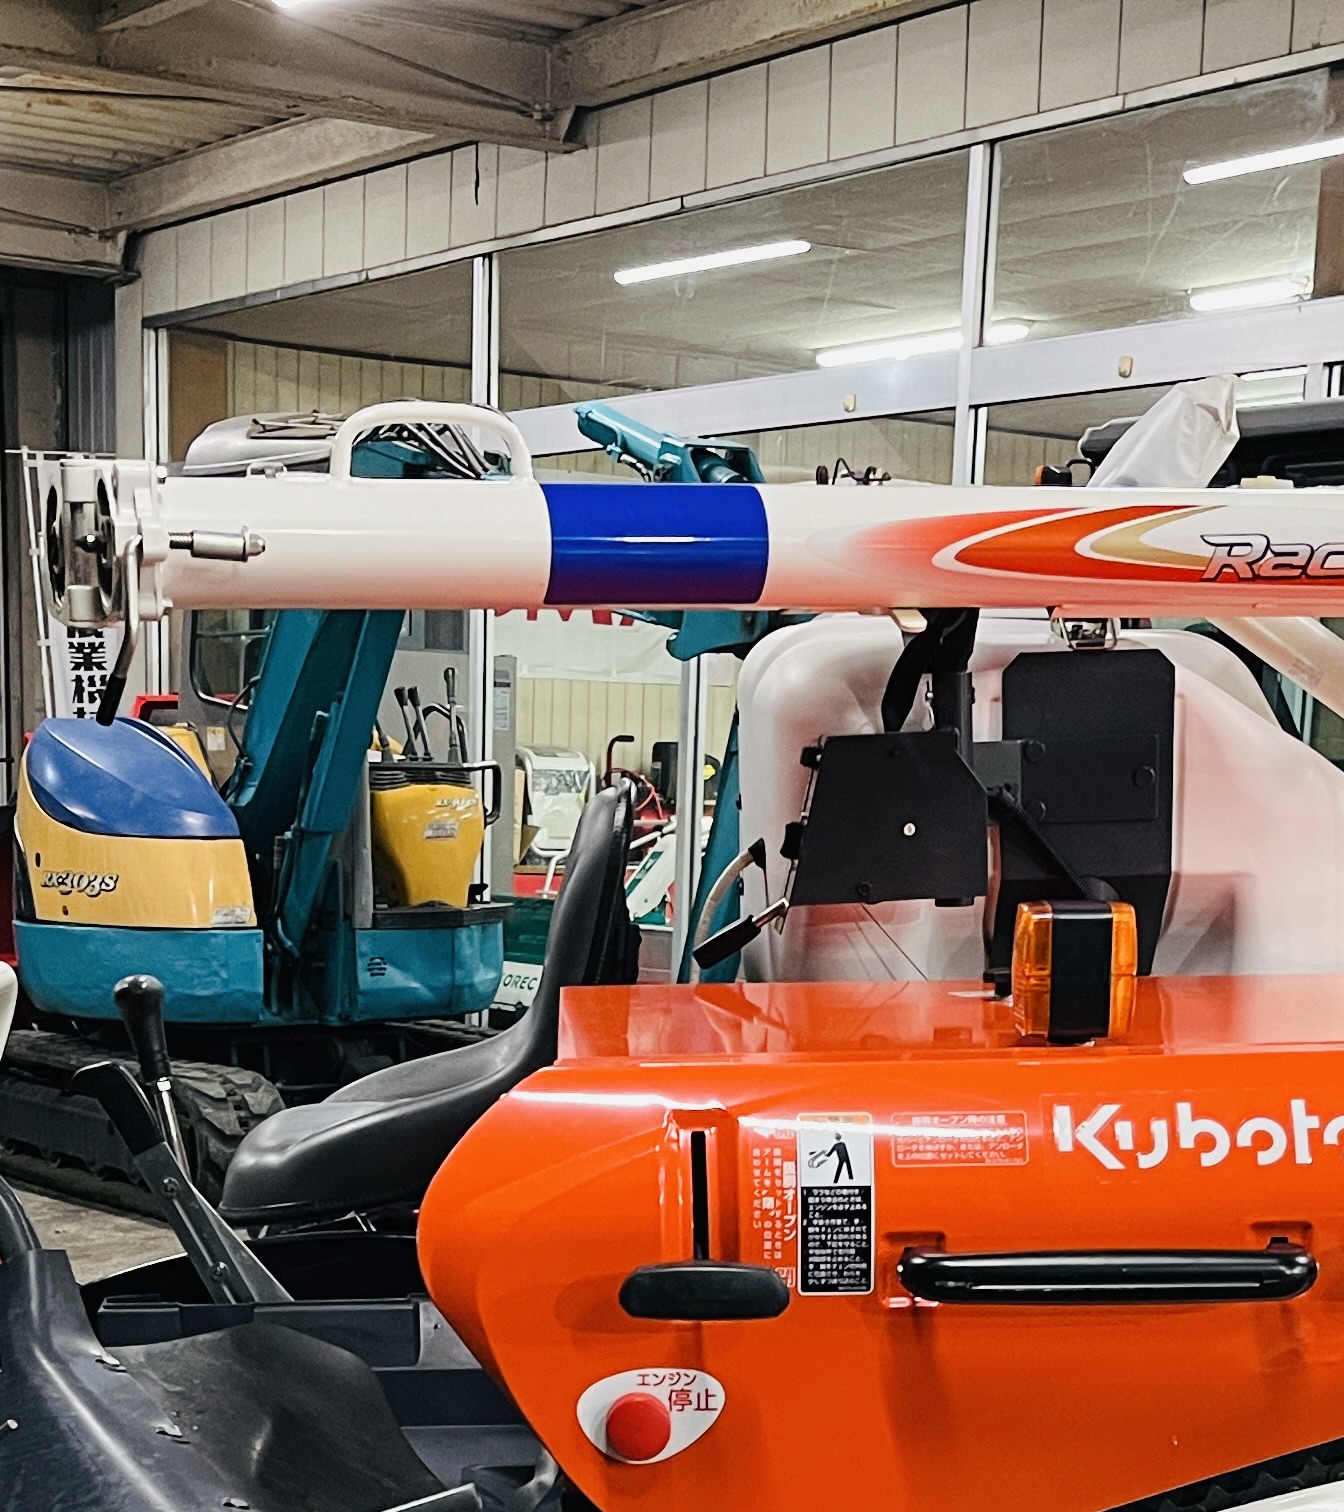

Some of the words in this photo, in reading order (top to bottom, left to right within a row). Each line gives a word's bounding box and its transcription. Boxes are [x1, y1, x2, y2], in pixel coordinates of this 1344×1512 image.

[636, 1371, 697, 1387] エンジン
[668, 1388, 718, 1412] 停止
